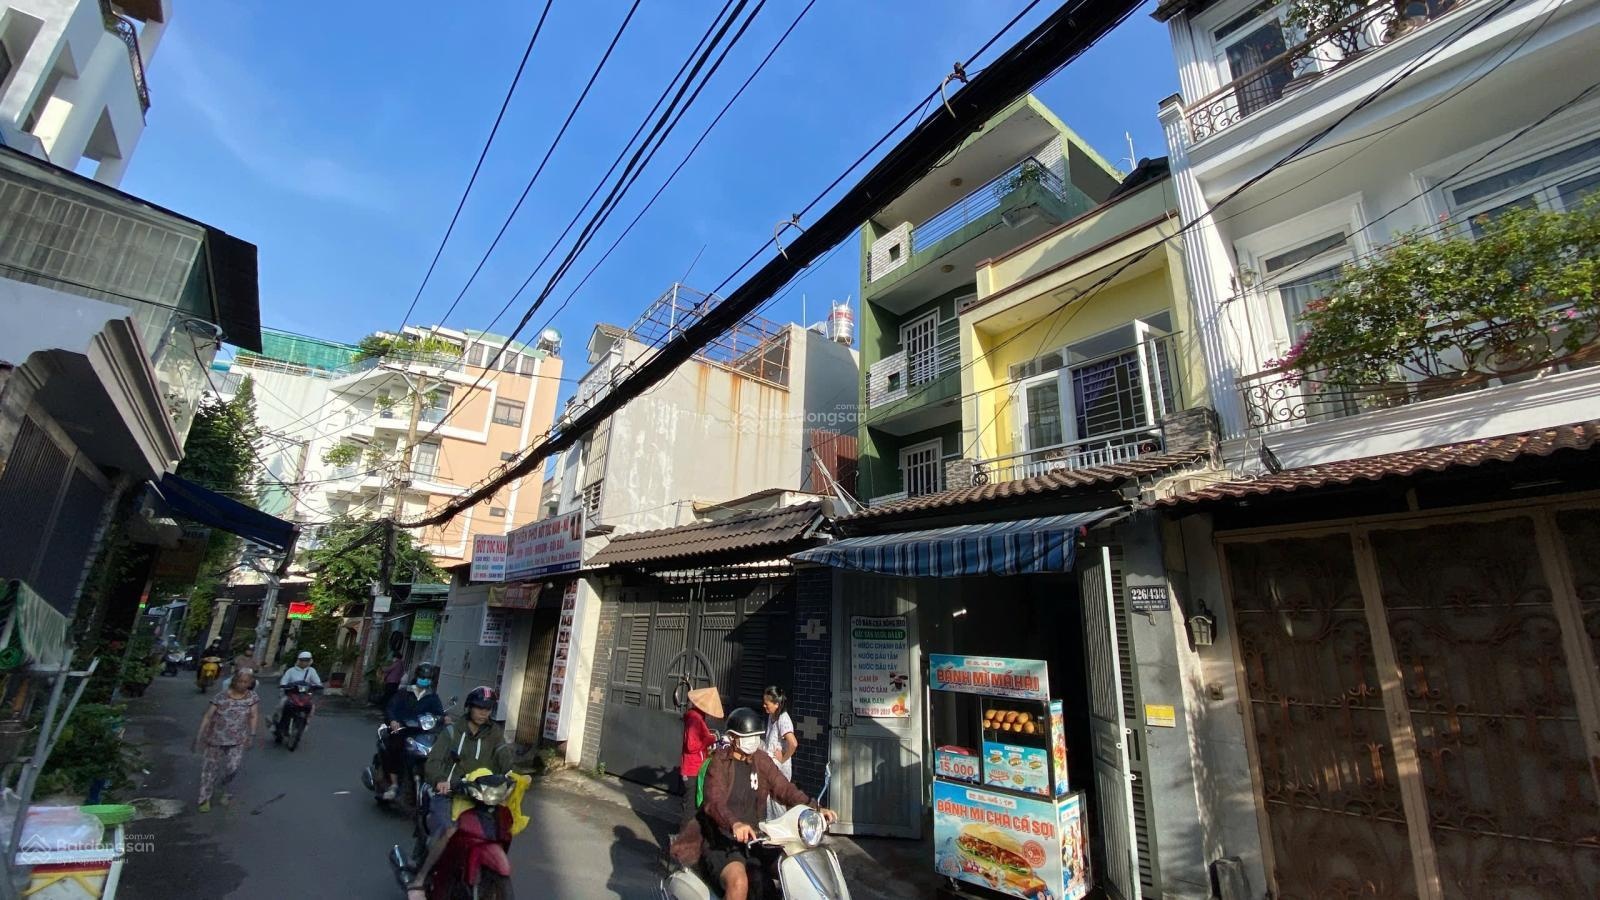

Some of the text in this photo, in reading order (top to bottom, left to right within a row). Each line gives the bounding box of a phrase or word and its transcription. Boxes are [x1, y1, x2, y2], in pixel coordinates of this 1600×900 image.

[936, 665, 972, 685] BÁNH
[972, 668, 990, 686] MÌ
[940, 760, 974, 777] 15.000
[937, 798, 968, 816] BÁNH
[986, 810, 1011, 828] CHẢ
[1013, 814, 1030, 833] CÁ
